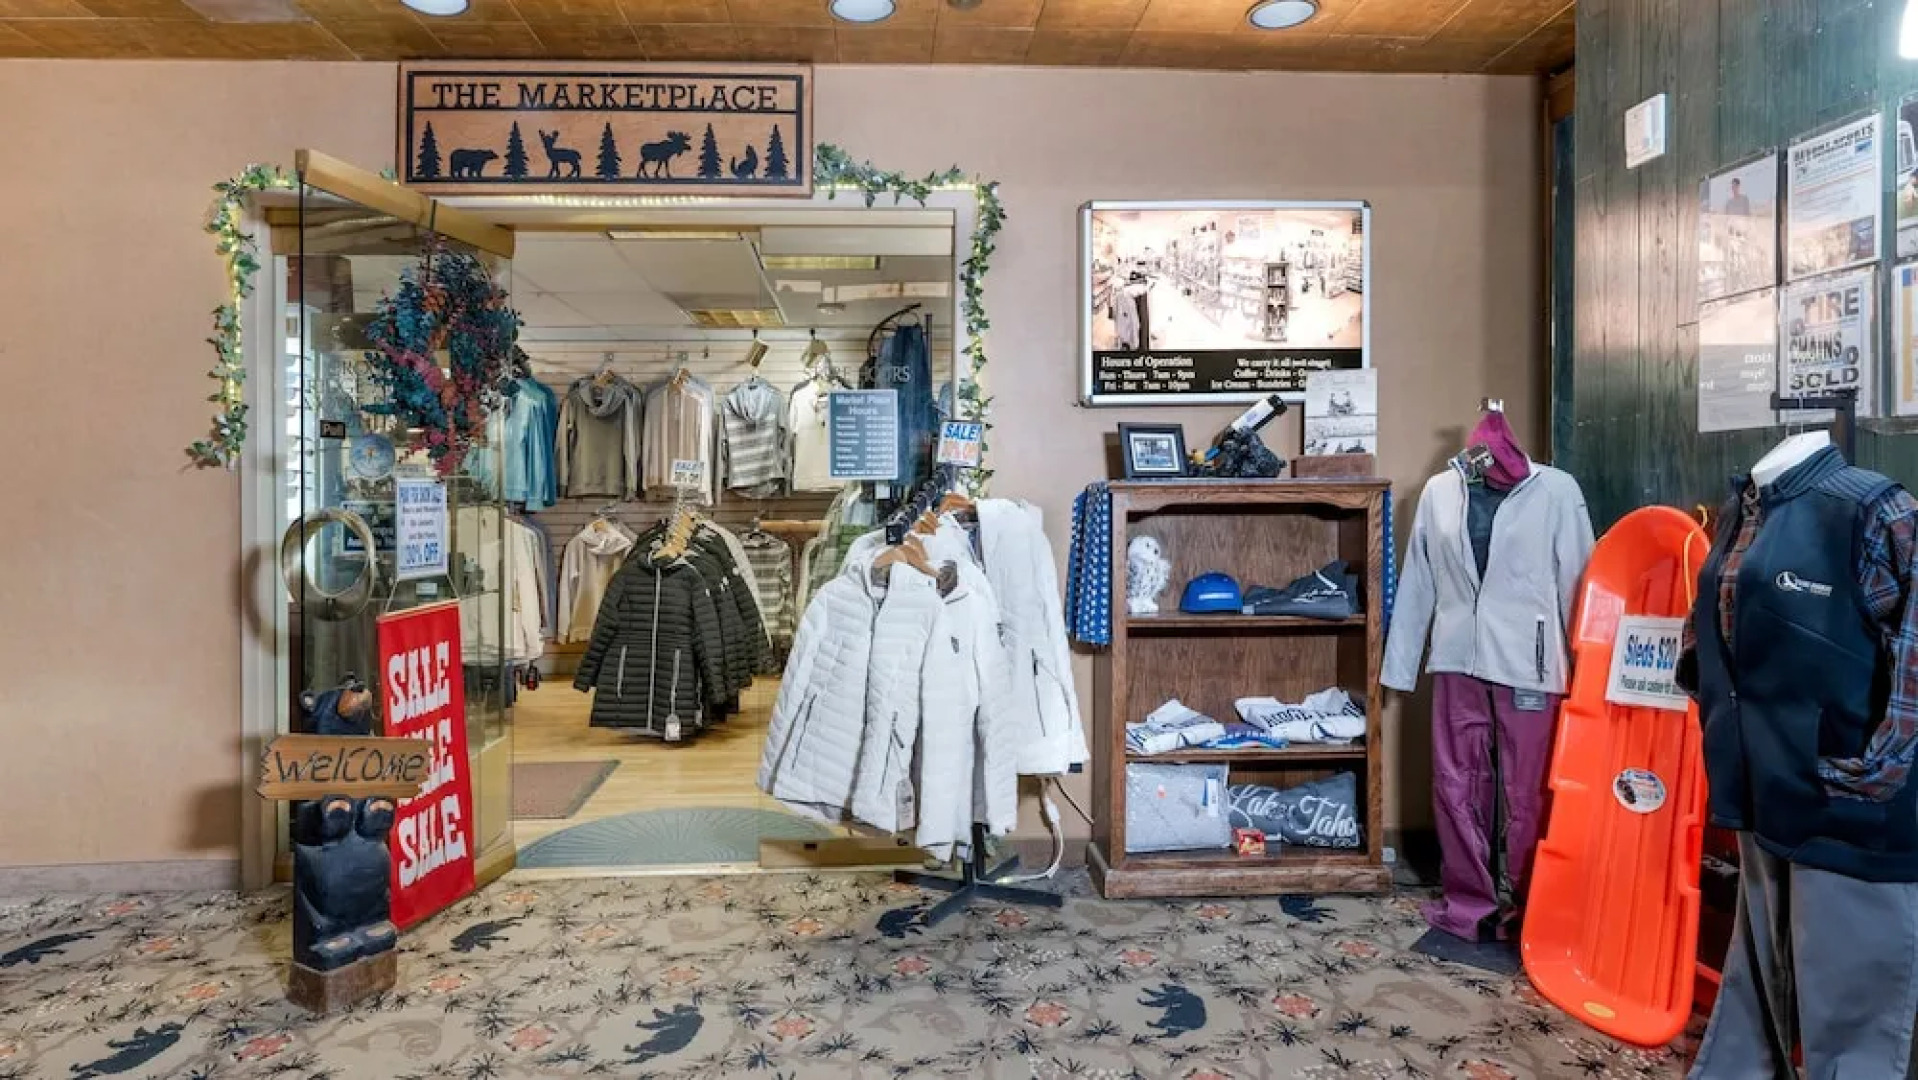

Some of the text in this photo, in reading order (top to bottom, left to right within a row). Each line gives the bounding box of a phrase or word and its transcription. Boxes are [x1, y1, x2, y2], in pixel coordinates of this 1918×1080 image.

[432, 83, 778, 111] THE MARKETPLACE
[1800, 286, 1859, 324] TIRE
[1101, 355, 1195, 369] Hours of Operation
[848, 406, 879, 416] Hours
[945, 423, 982, 442] SALE!
[1624, 634, 1656, 668] Sleds
[388, 641, 451, 725] SALE
[1288, 795, 1358, 836] Taho
[397, 796, 467, 889] SALE
